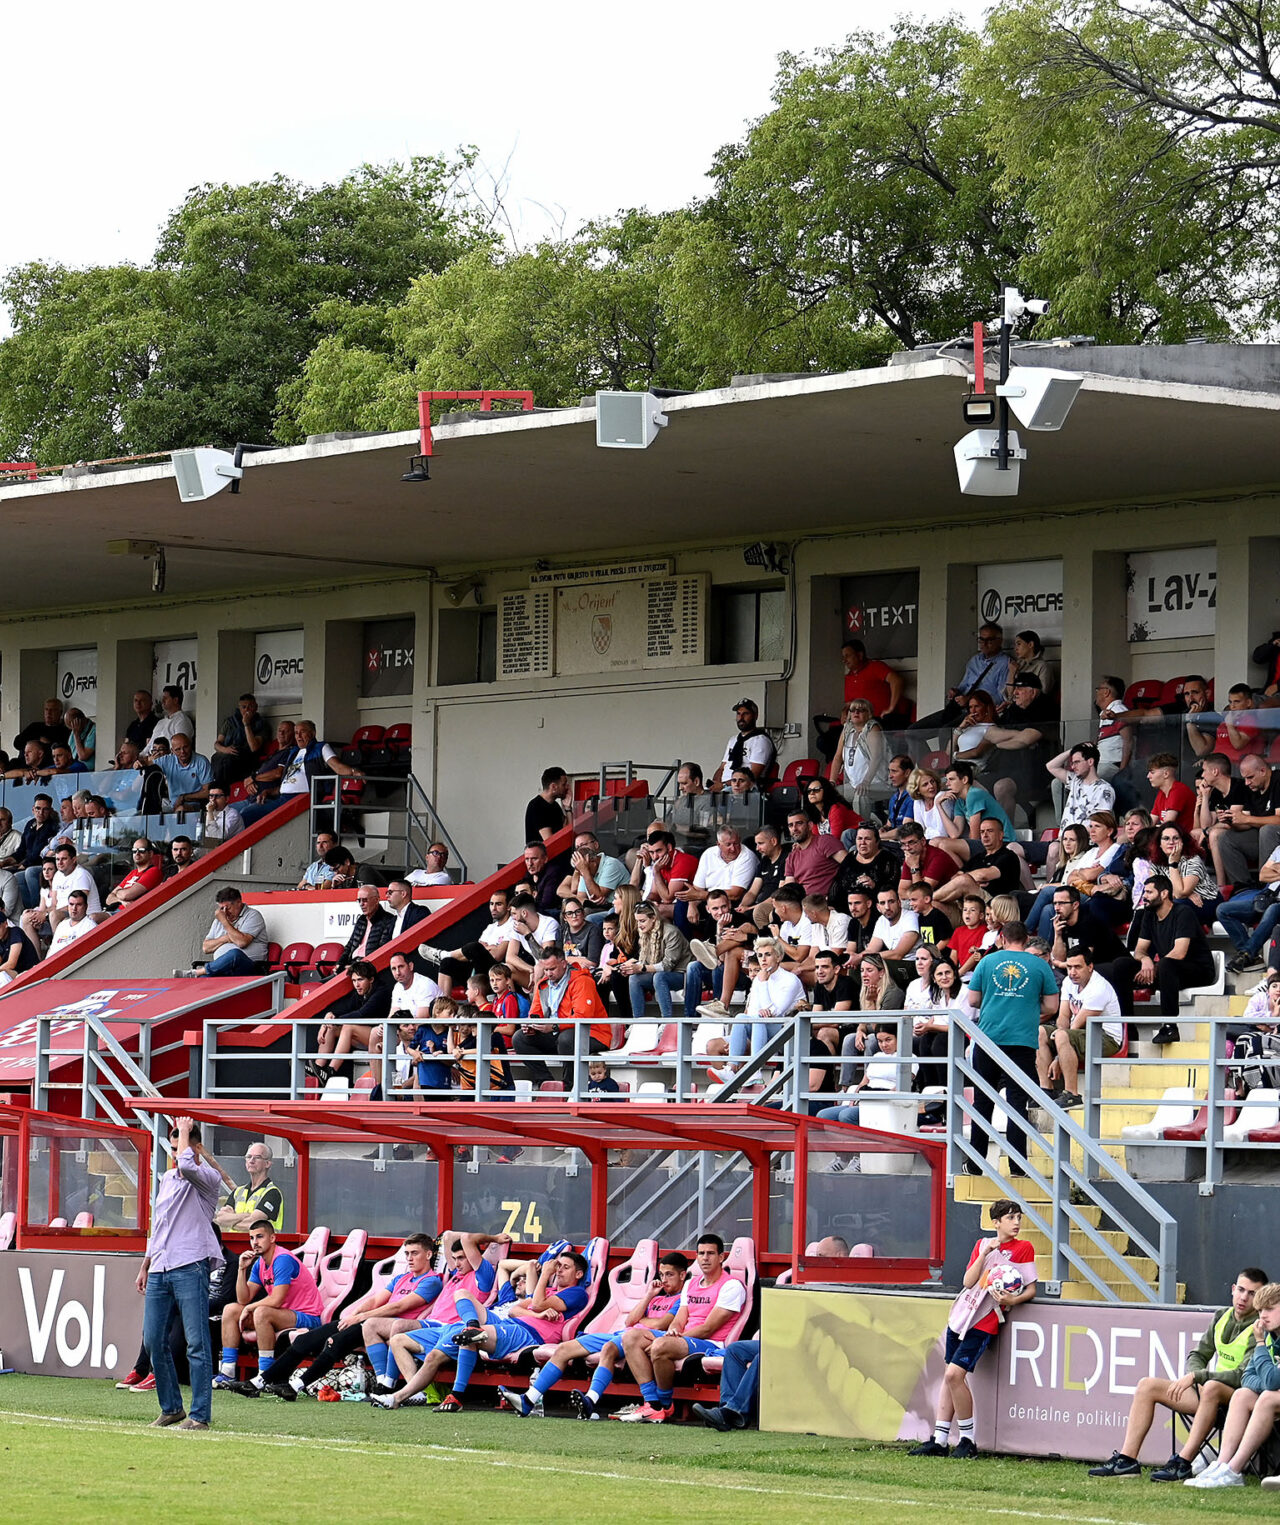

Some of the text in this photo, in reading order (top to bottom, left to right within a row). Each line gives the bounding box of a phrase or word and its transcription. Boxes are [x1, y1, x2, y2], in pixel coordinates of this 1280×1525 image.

[866, 604, 916, 627] TEXT
[384, 649, 414, 667] TEX
[337, 914, 351, 926] VIP
[18, 1264, 118, 1370] Vol.
[1009, 1403, 1070, 1423] dentalne
